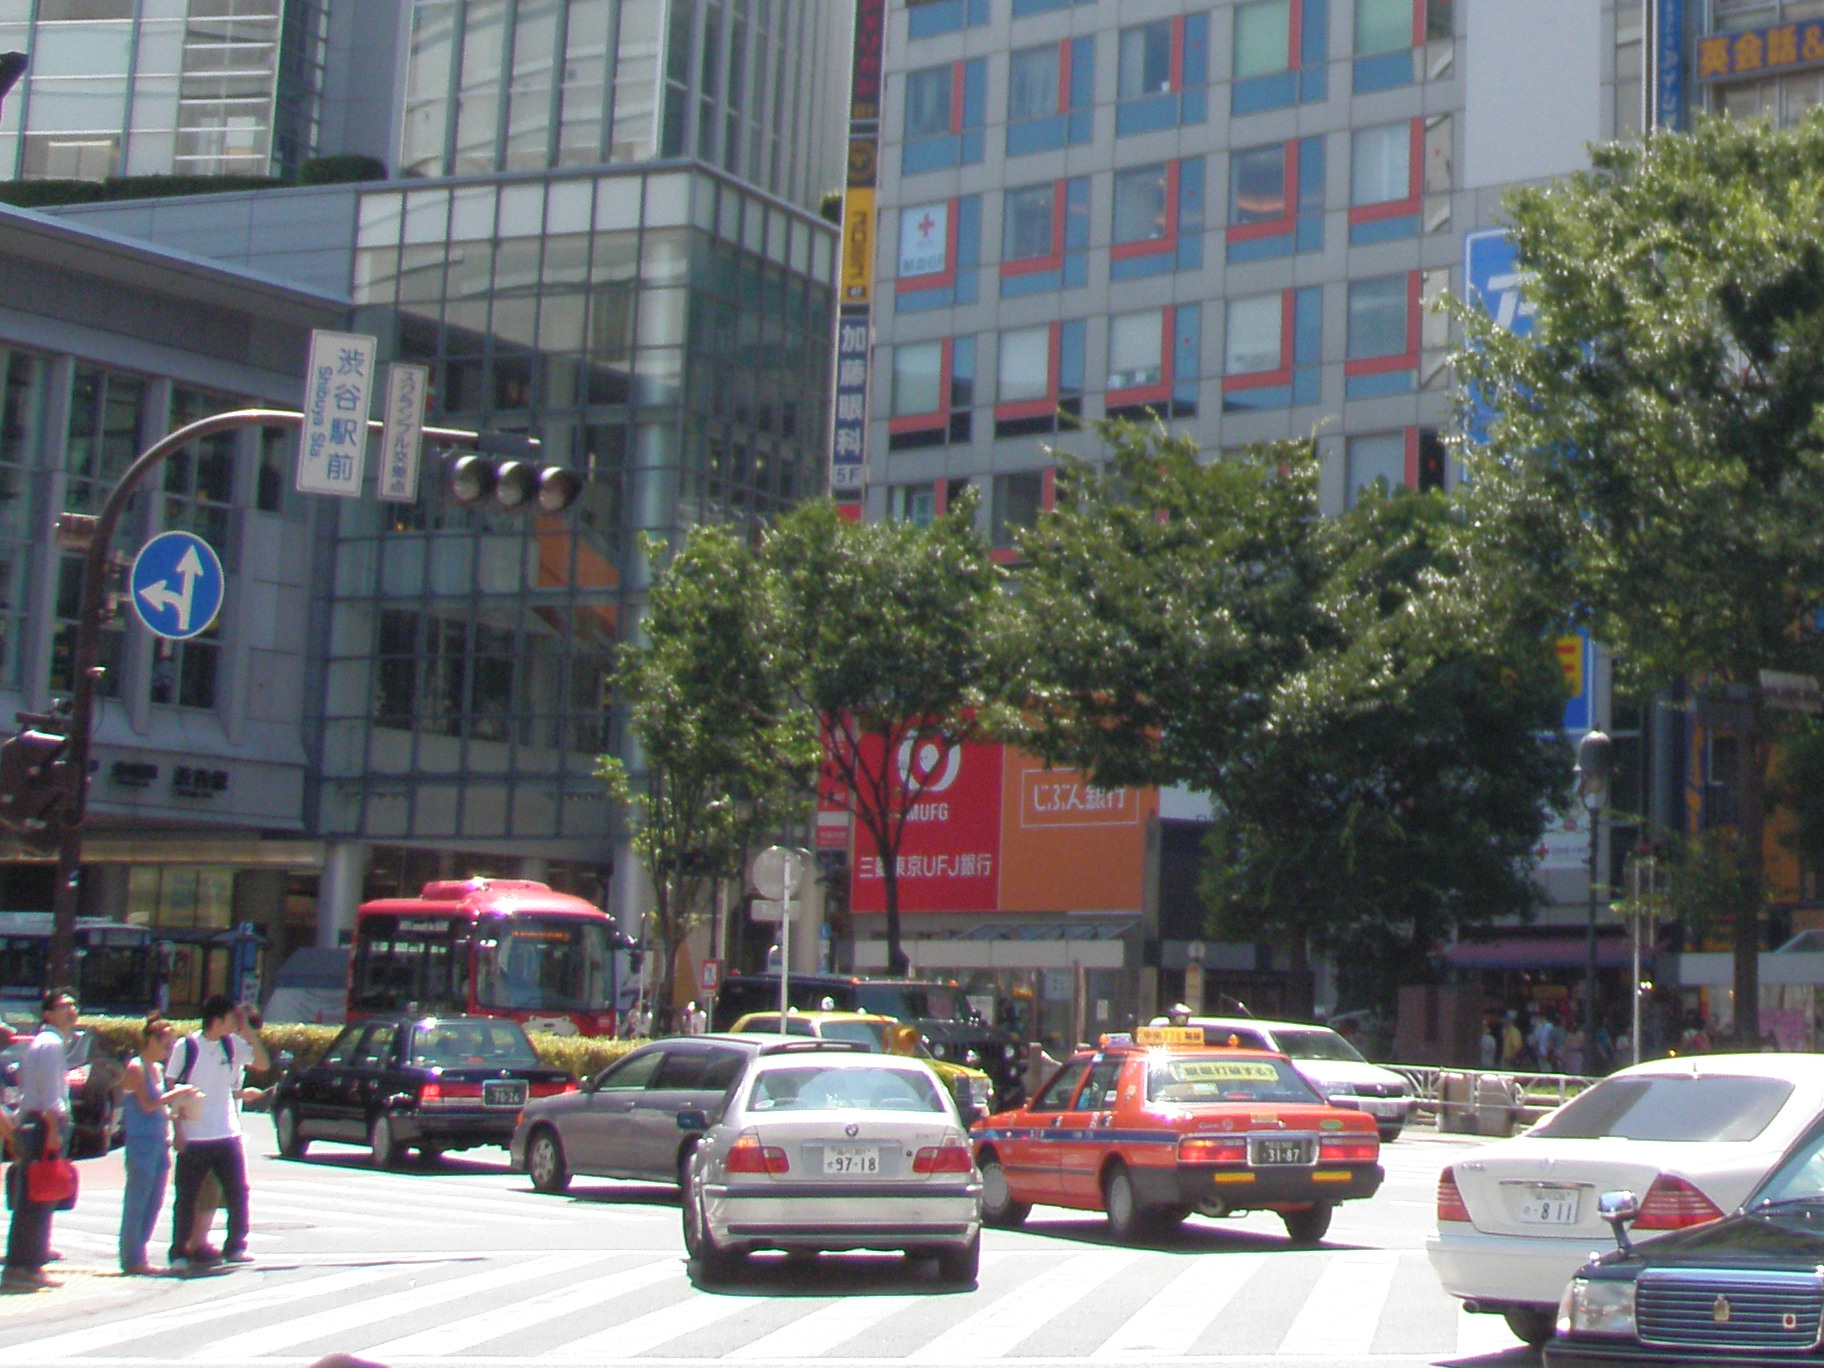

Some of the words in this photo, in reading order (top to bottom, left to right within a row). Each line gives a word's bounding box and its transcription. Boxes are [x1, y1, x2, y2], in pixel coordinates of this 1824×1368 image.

[312, 366, 333, 426] Shibuya
[327, 348, 365, 482] 渋谷駅前
[837, 468, 859, 482] 5F
[1034, 785, 1126, 811] じぶん銀行
[906, 803, 949, 821] MUFG
[836, 1157, 876, 1171] 97-18
[1268, 1148, 1300, 1162] 31-87
